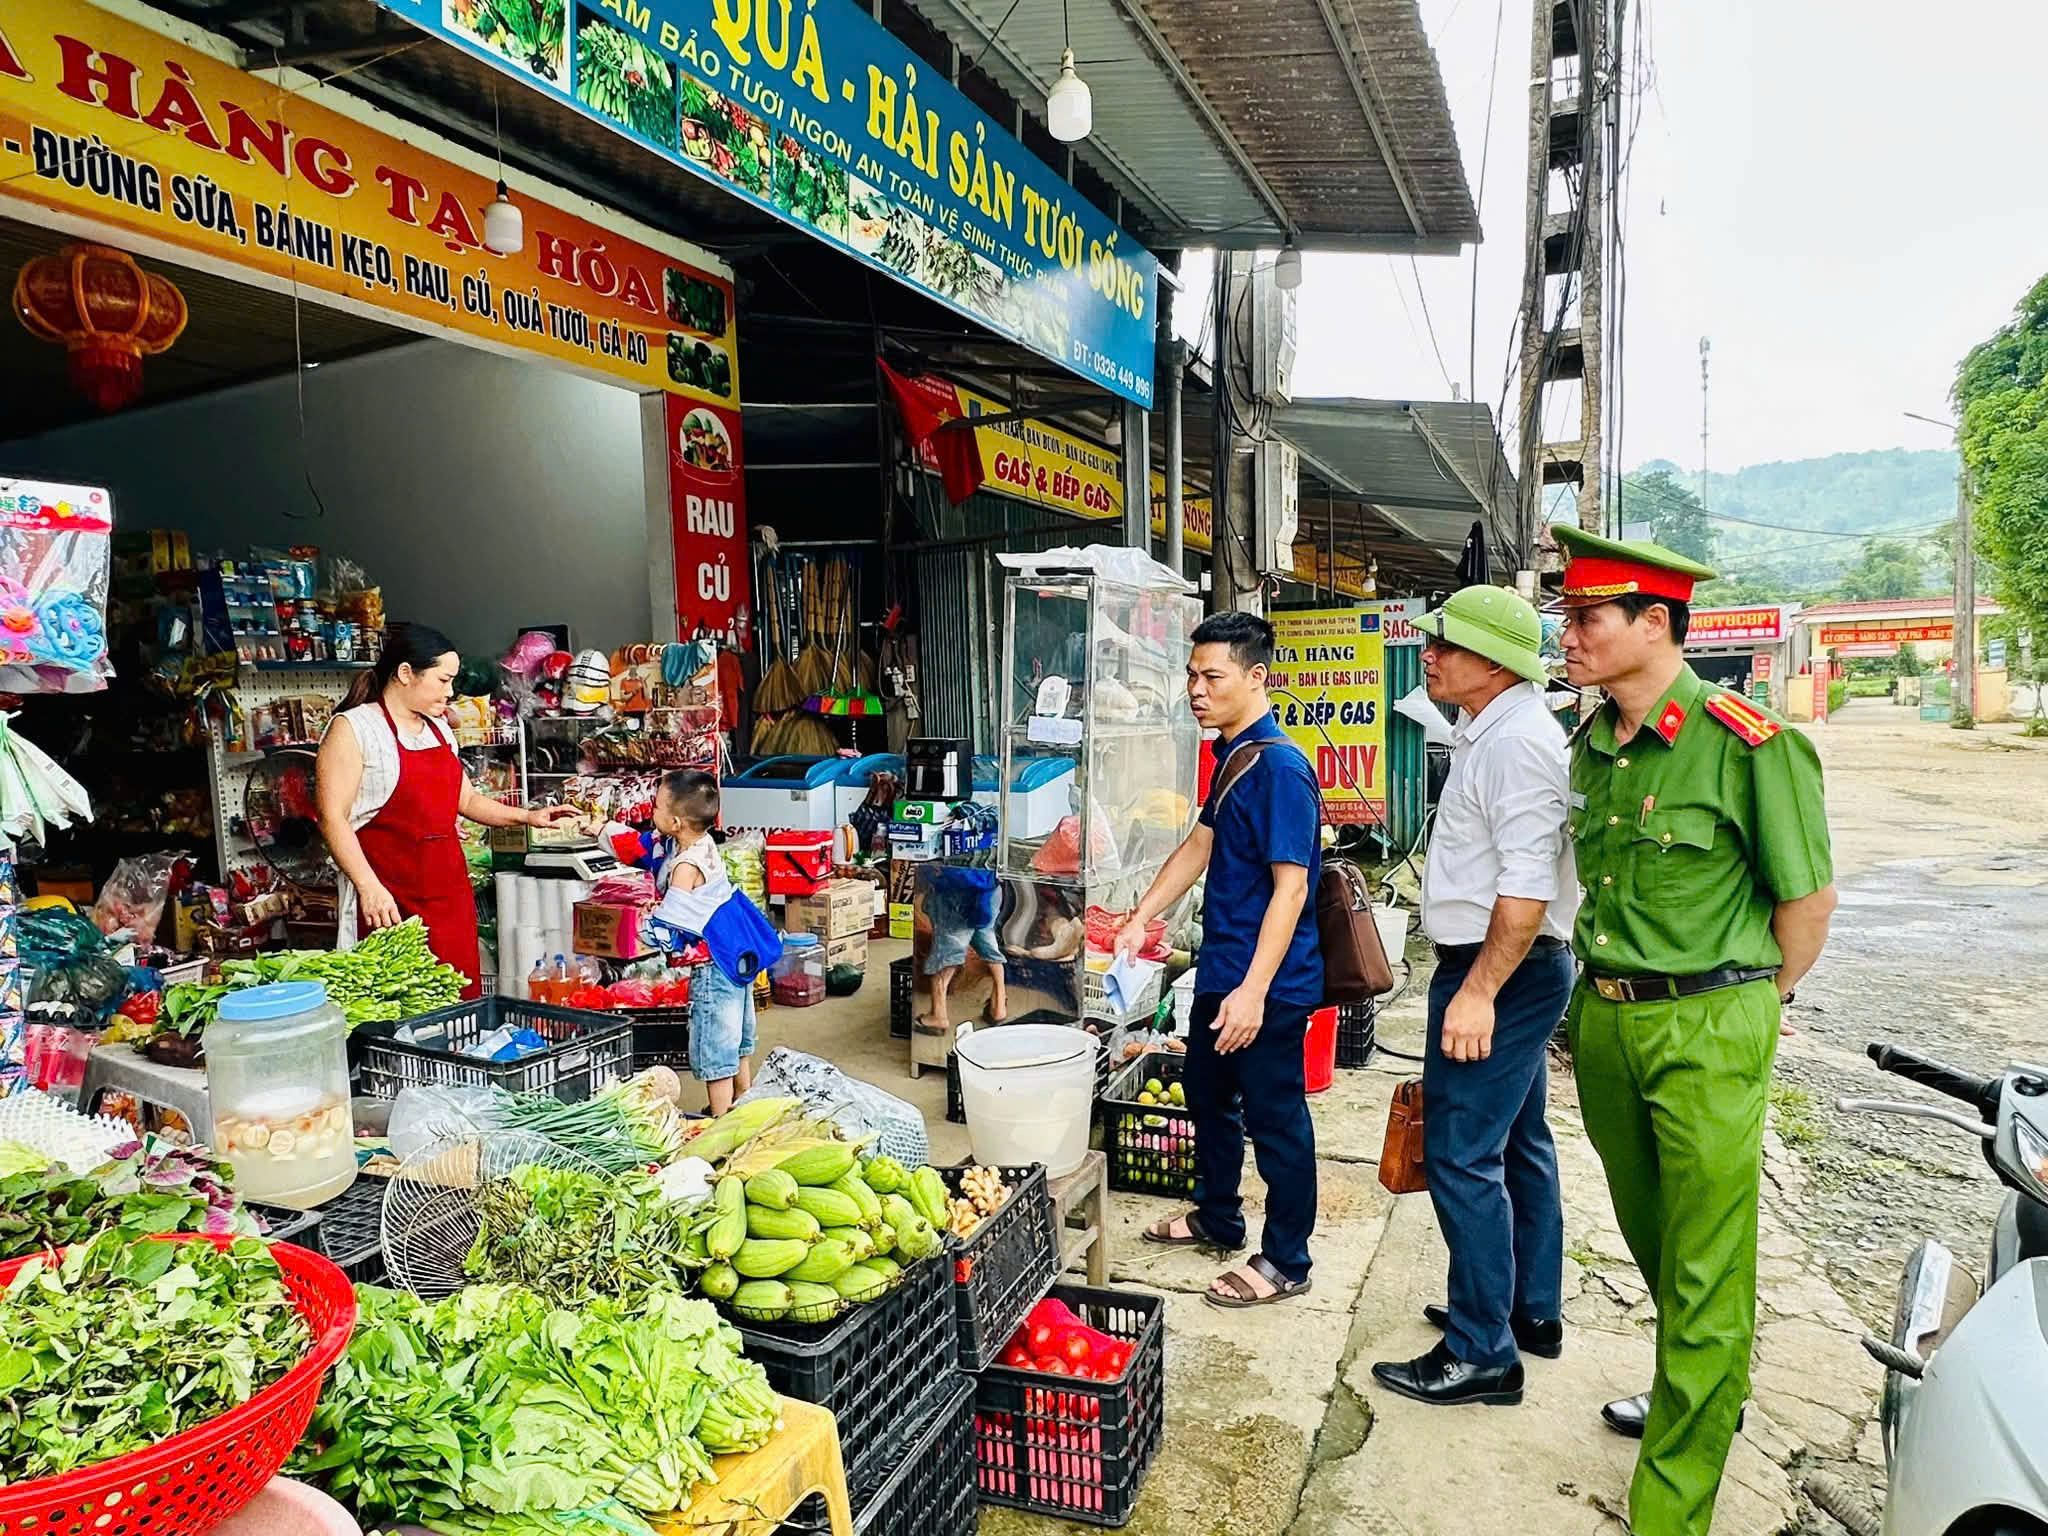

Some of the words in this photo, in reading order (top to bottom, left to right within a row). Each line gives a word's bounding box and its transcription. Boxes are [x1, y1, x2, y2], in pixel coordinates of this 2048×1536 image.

[659, 21, 720, 77] BẢO
[728, 64, 784, 121] TƯƠI
[790, 105, 852, 164] NGON
[855, 152, 884, 184] AN
[888, 171, 935, 218] TOÀN
[938, 202, 960, 235] VỆ
[962, 220, 996, 254] SINH
[54, 33, 360, 198] HÀNG
[375, 165, 510, 259] TẠ
[535, 230, 659, 315] HÓA
[866, 63, 940, 180] HẢI
[949, 120, 1015, 232] SẢN
[1022, 184, 1085, 280] TƯƠI
[1088, 230, 1144, 321] SỐNG
[32, 125, 163, 215] ĐƯỜNG
[171, 174, 248, 246] SỮA,
[254, 201, 334, 268] BÁNH
[341, 231, 400, 293] KẸO,
[404, 253, 457, 312] RAU,
[462, 267, 499, 324] CỦ,
[503, 288, 544, 335] QUẢ
[548, 303, 595, 355] TƯƠI,
[598, 318, 621, 363] CÁ
[625, 331, 648, 367] AO
[1094, 350, 1117, 381] 0326
[1117, 365, 1134, 392] 449
[994, 451, 1030, 487] GAS
[1035, 465, 1047, 493] &
[1053, 464, 1080, 501] BẾP
[1083, 482, 1110, 513] GAS
[686, 494, 735, 539] RAU
[697, 552, 730, 602] CỦ
[1689, 611, 1777, 629] HOTOCOPY
[1305, 642, 1355, 662] HÀNG
[1333, 670, 1351, 686] GAS
[1303, 690, 1336, 726] BẾP
[1340, 701, 1376, 725] GAS
[1316, 745, 1378, 790] DUY
